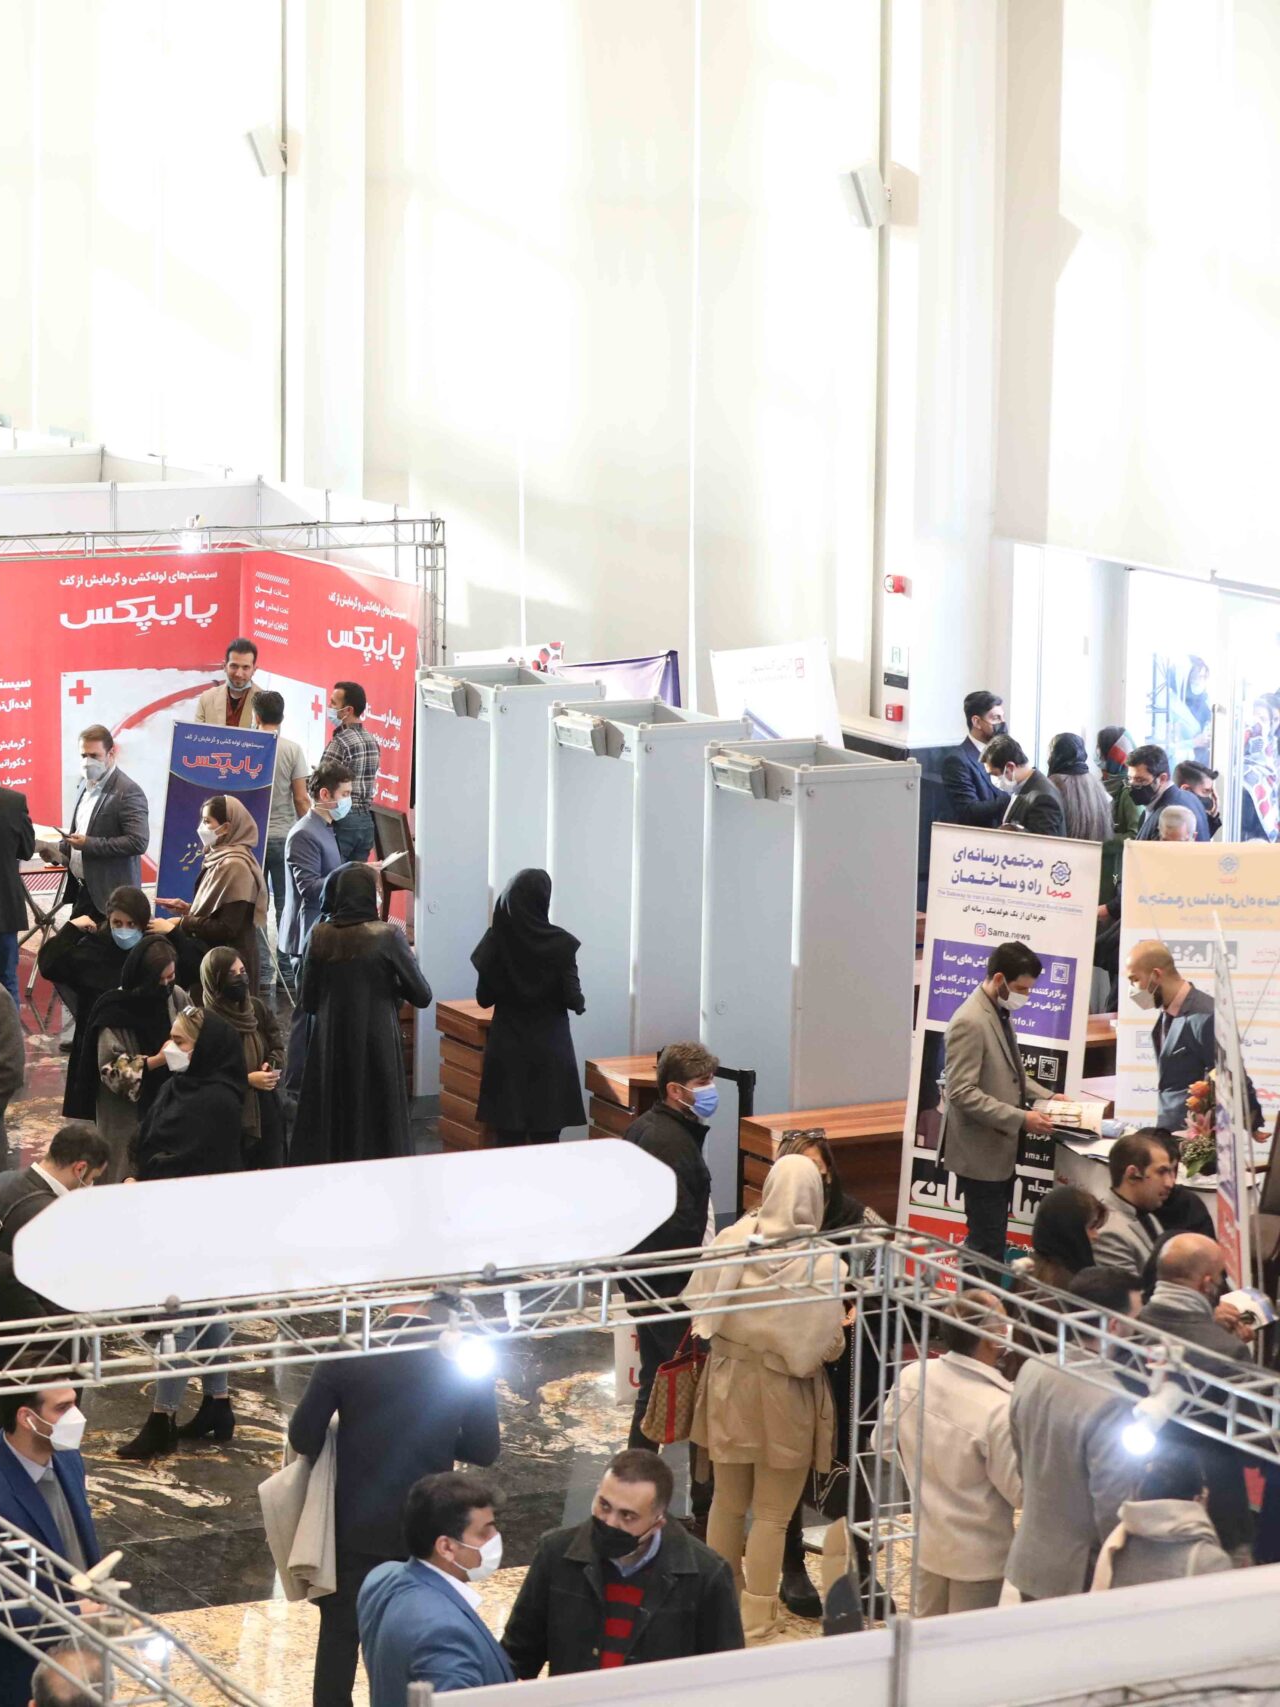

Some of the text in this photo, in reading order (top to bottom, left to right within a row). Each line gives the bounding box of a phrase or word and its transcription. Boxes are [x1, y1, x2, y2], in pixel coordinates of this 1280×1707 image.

[59, 575, 75, 586] کف
[76, 575, 83, 588] از
[84, 572, 121, 587] گرمایش
[121, 576, 127, 586] و
[1001, 853, 1044, 871] مجتمع
[951, 868, 1042, 895] راه و ساختمان
[987, 928, 1031, 941] Sama.news
[942, 951, 958, 962] صما
[1010, 1016, 1036, 1028] nfo.ir
